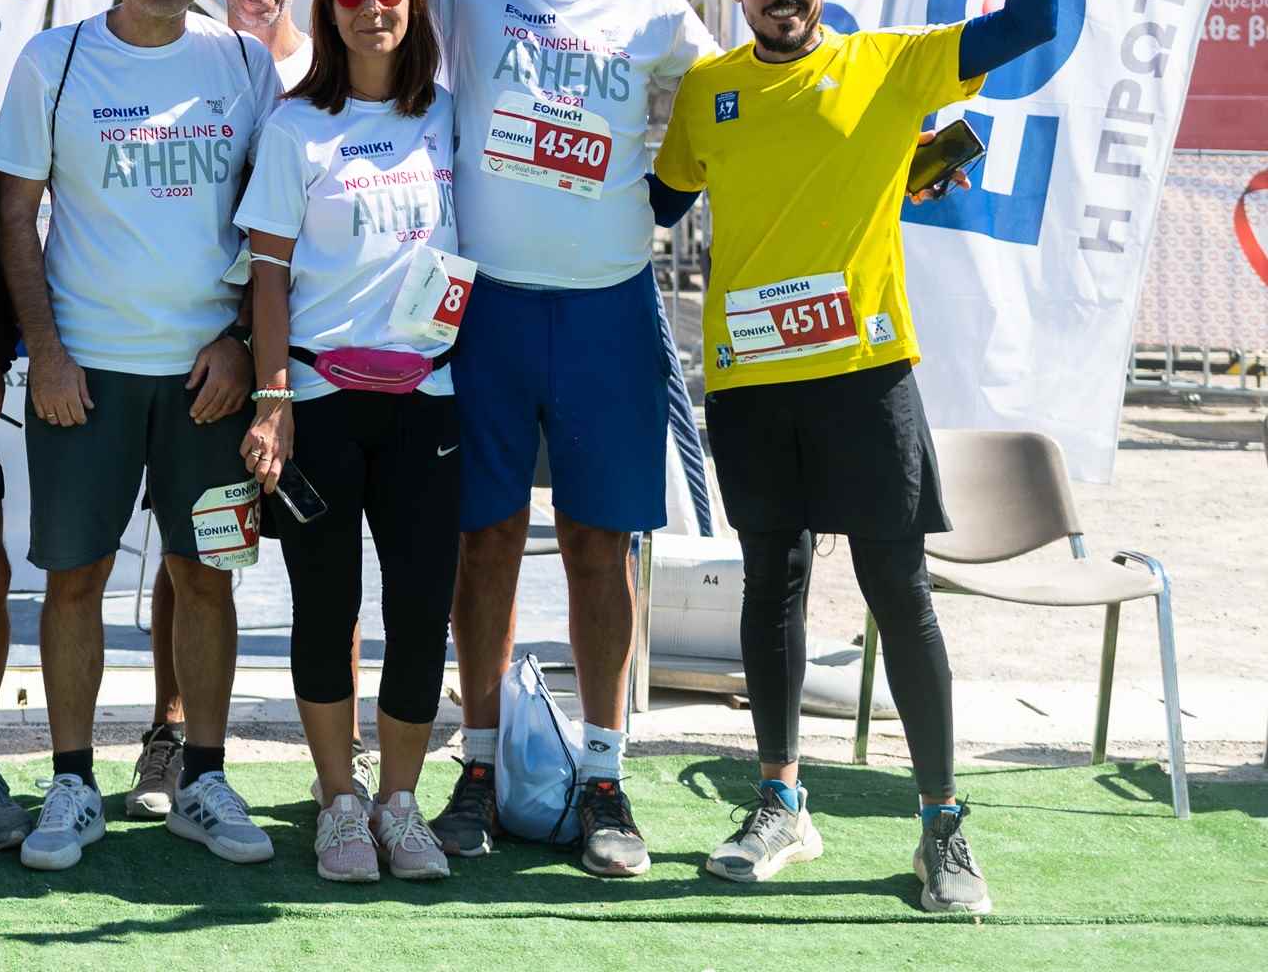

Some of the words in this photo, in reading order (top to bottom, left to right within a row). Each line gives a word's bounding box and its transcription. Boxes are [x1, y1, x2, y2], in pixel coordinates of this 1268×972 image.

[101, 128, 126, 143] NO
[129, 126, 180, 141] FINISH
[183, 124, 217, 139] LINE
[538, 129, 606, 168] 4540
[102, 139, 232, 189] ATHENS
[165, 187, 194, 197] 2021
[344, 177, 370, 191] NO
[781, 297, 846, 336] 4511
[702, 573, 719, 586] A4
